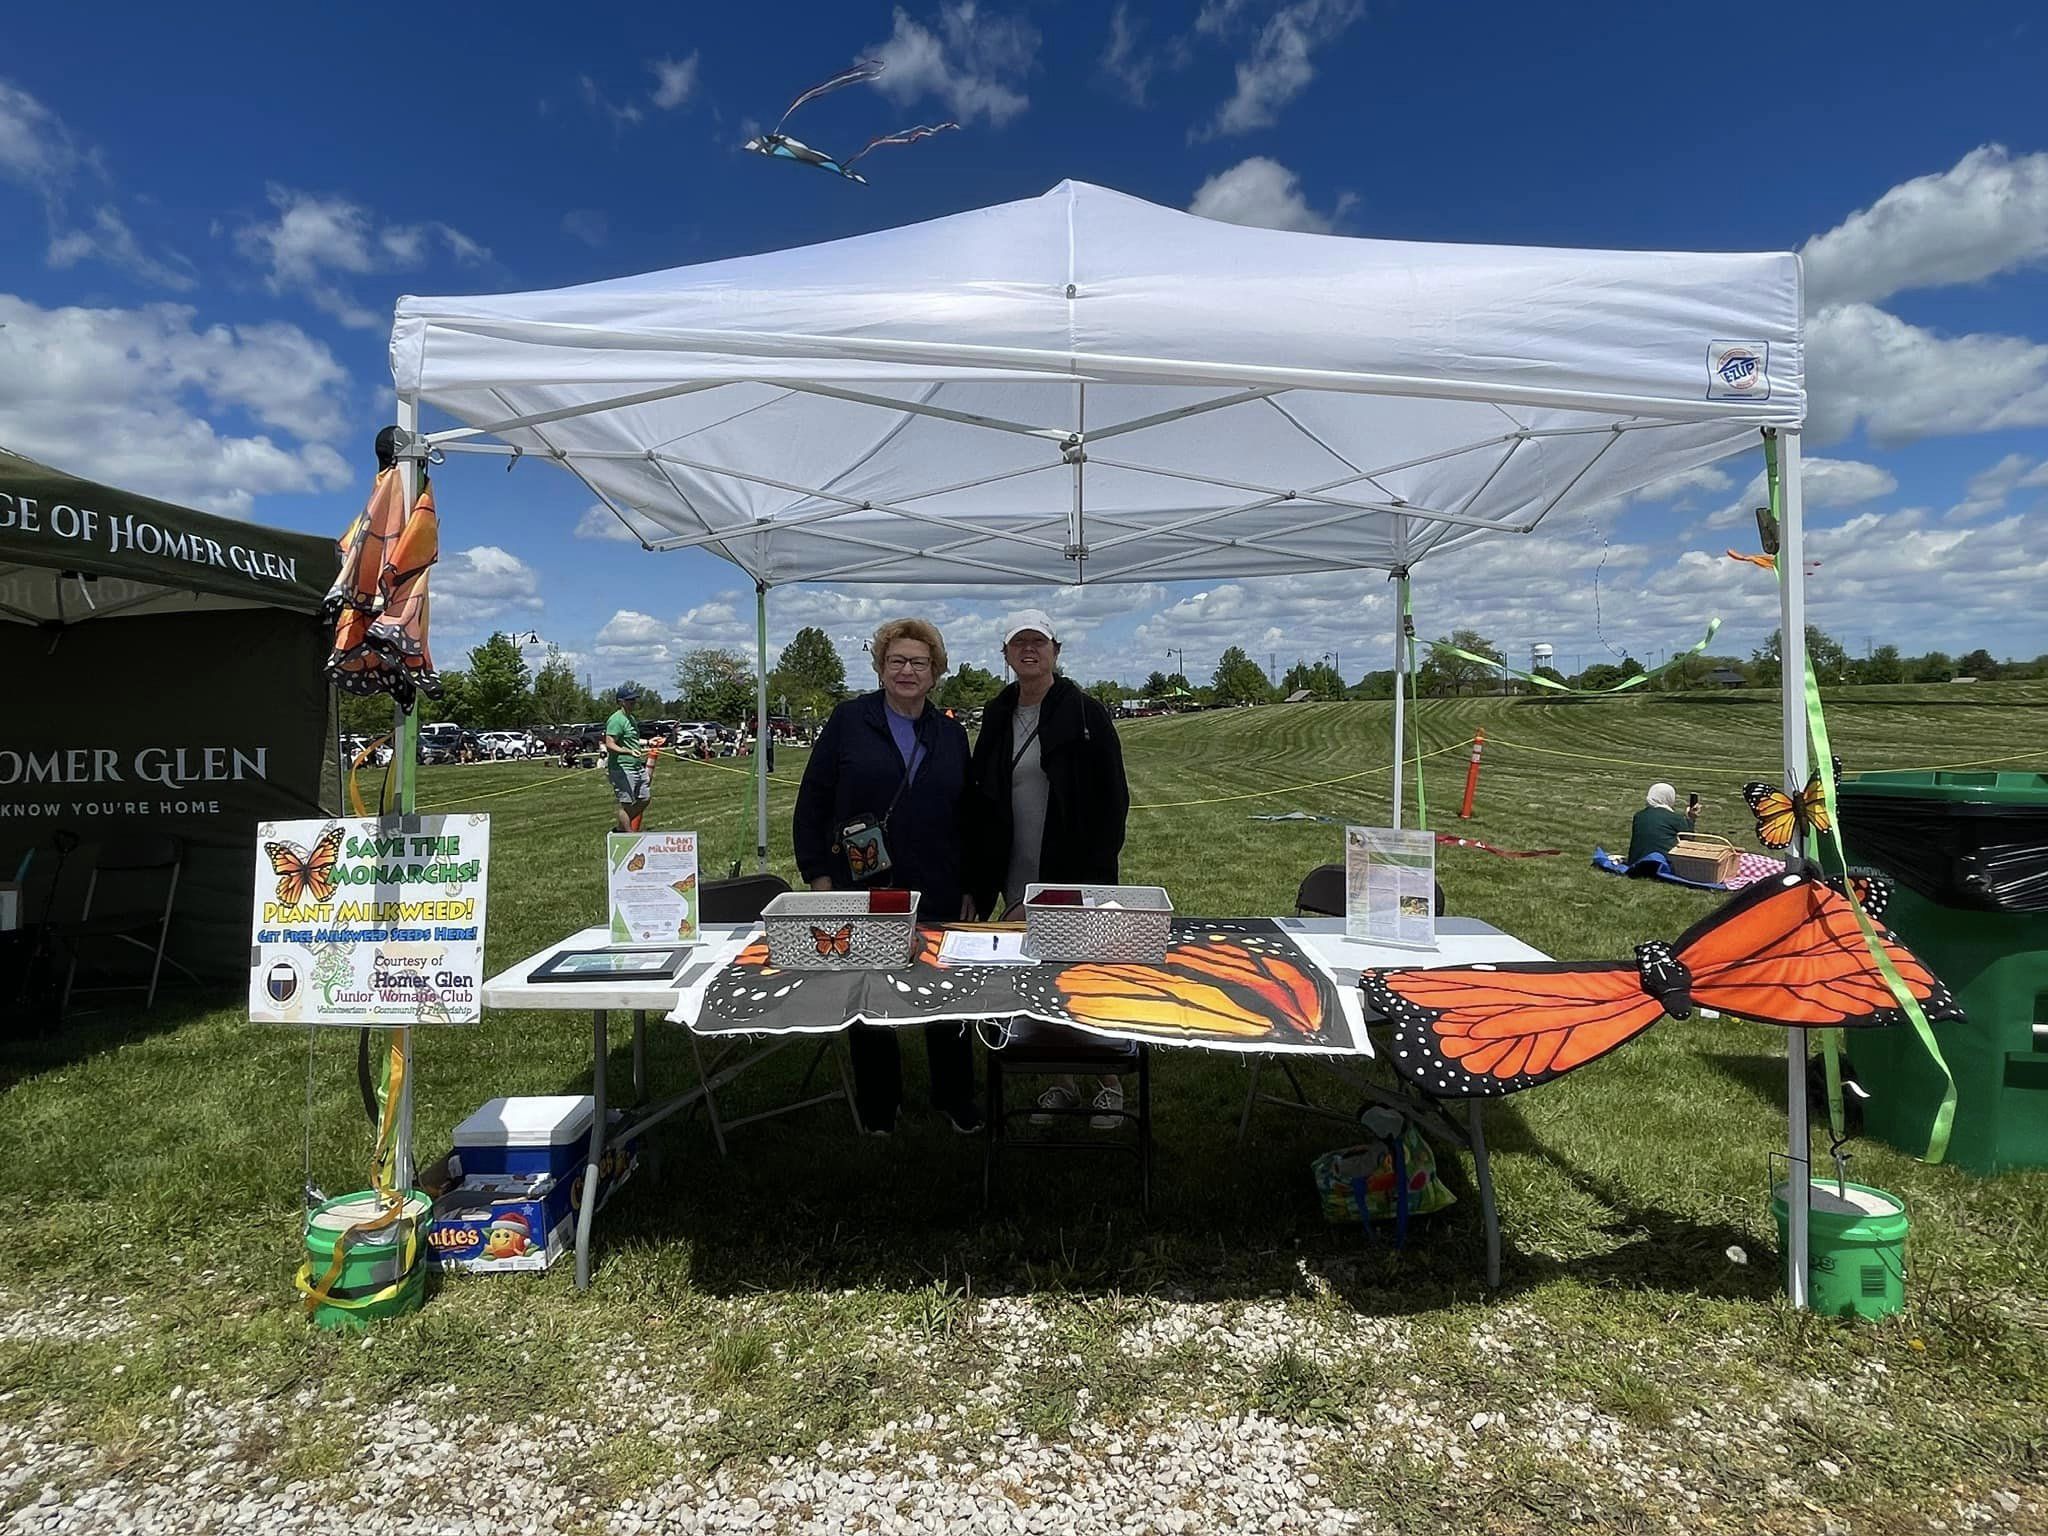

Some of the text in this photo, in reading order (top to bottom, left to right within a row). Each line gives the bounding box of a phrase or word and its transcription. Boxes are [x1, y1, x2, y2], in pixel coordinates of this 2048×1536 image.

[50, 504, 99, 542] OF
[108, 514, 228, 569] HOMER
[229, 545, 298, 584] GLEN
[134, 747, 269, 790] GLEN
[1, 800, 221, 817] KNOW YOU'RE HOME
[346, 835, 460, 858] SAVE THE
[665, 837, 693, 845] PLANT
[327, 860, 481, 886] MONARCHS!
[263, 898, 475, 924] PLANT MILKWEED!
[257, 926, 479, 943] GET FREE MILKWEED SEEDS HERE!
[374, 954, 444, 969] Courtesy of
[374, 971, 473, 988] Homer Glen
[335, 989, 374, 1003] Junior
[440, 989, 473, 1003] Club
